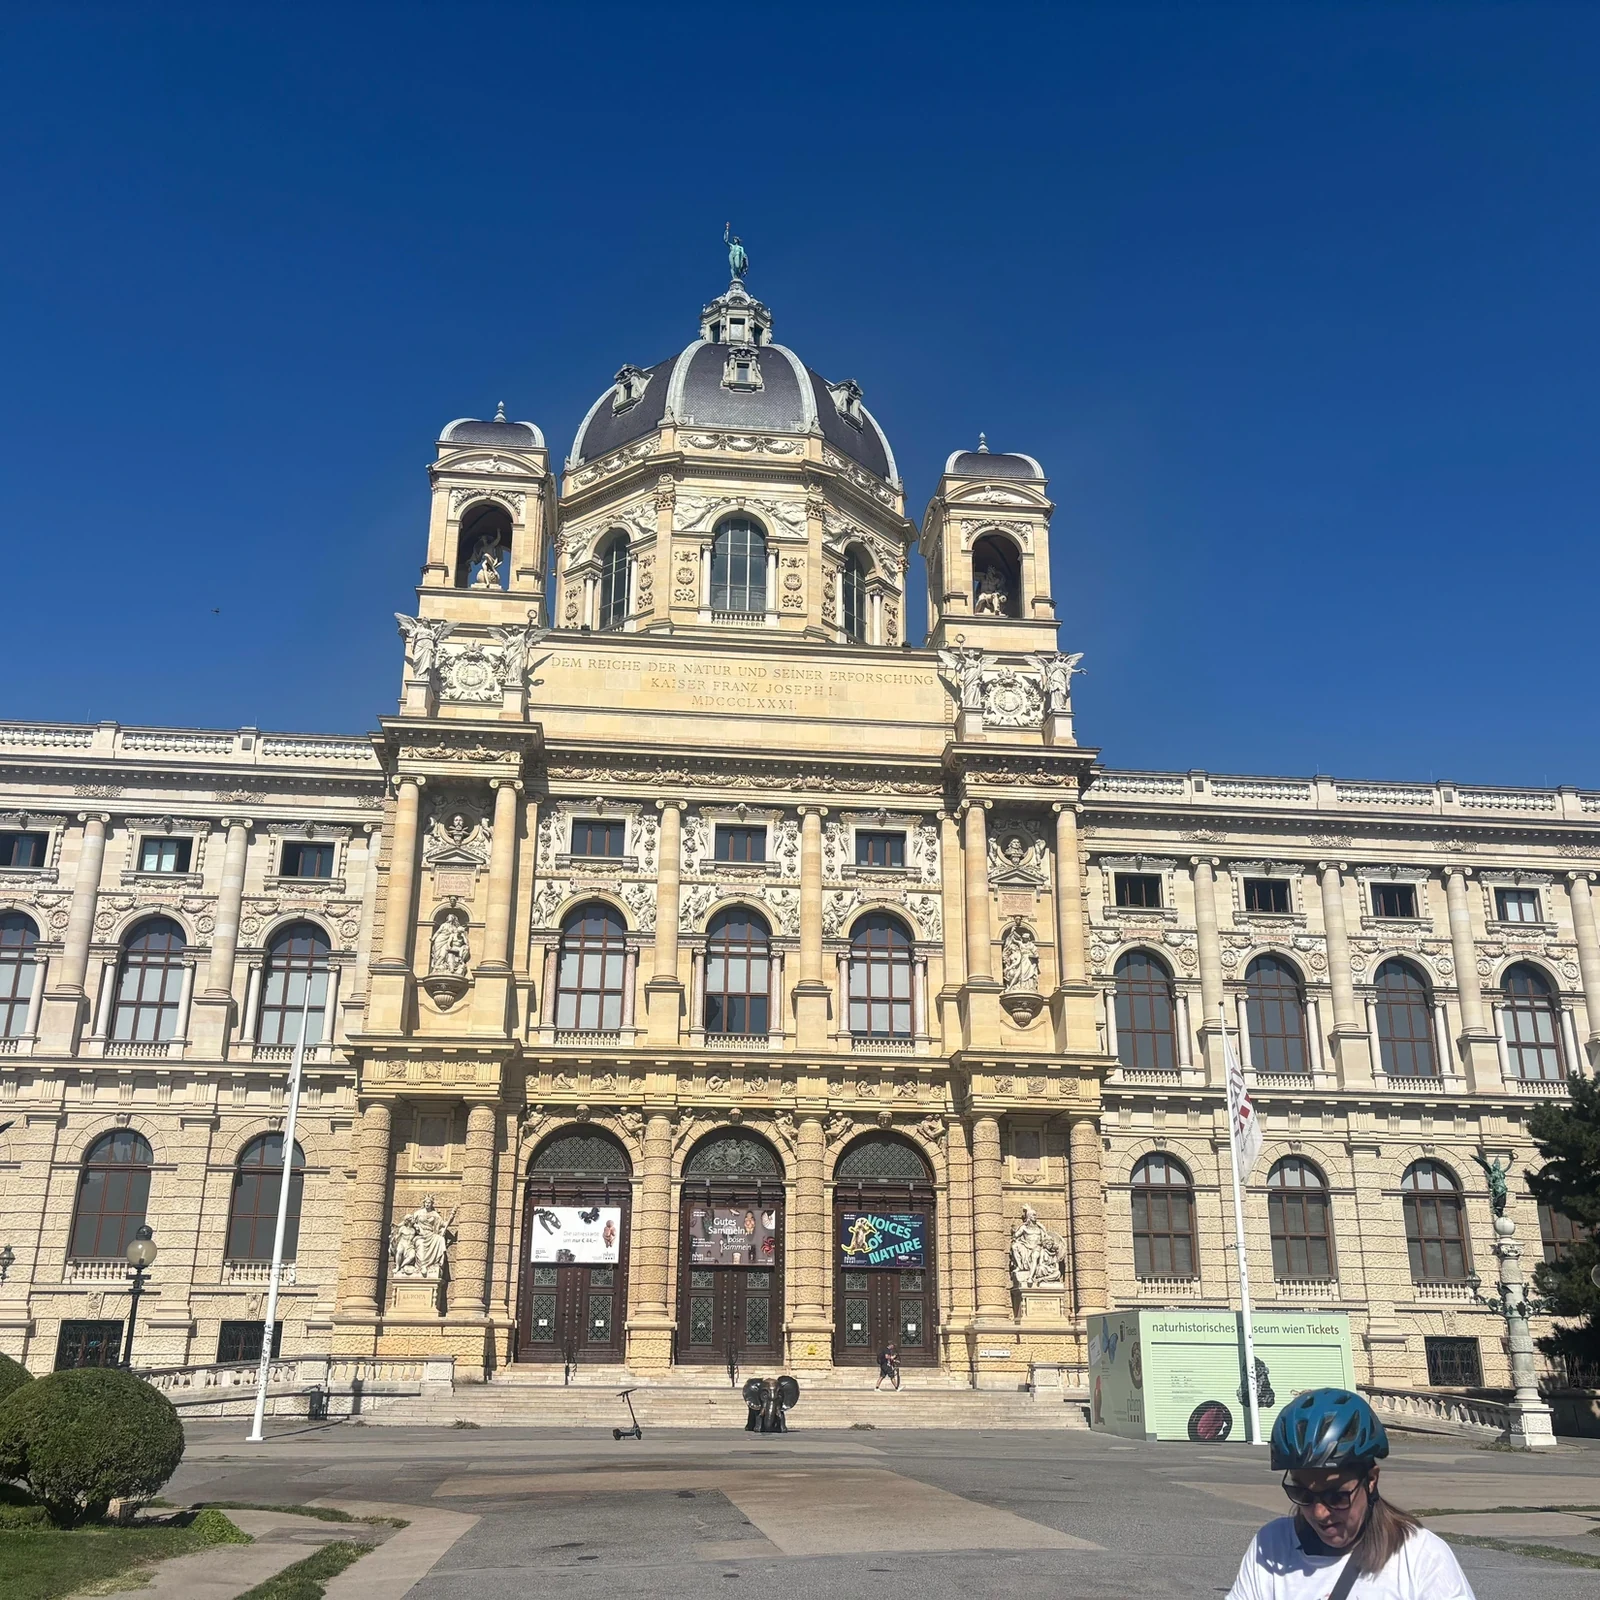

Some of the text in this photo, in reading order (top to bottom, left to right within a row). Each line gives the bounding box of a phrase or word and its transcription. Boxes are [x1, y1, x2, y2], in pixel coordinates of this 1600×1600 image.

[551, 656, 934, 685] DEM REICHE DER NATUR UND SEINER ERFORSCHUNG
[651, 678, 706, 690] KAISER
[713, 682, 758, 693] FRANZ
[766, 684, 824, 696] JOSEPH
[713, 1217, 736, 1226] Gutes
[868, 1214, 912, 1239] VOICES
[708, 1226, 748, 1236] Sammeln,
[868, 1232, 883, 1249] OF
[868, 1238, 922, 1264] NATURE
[1152, 1322, 1340, 1335] naturhistorisches mseum wien Tickets
